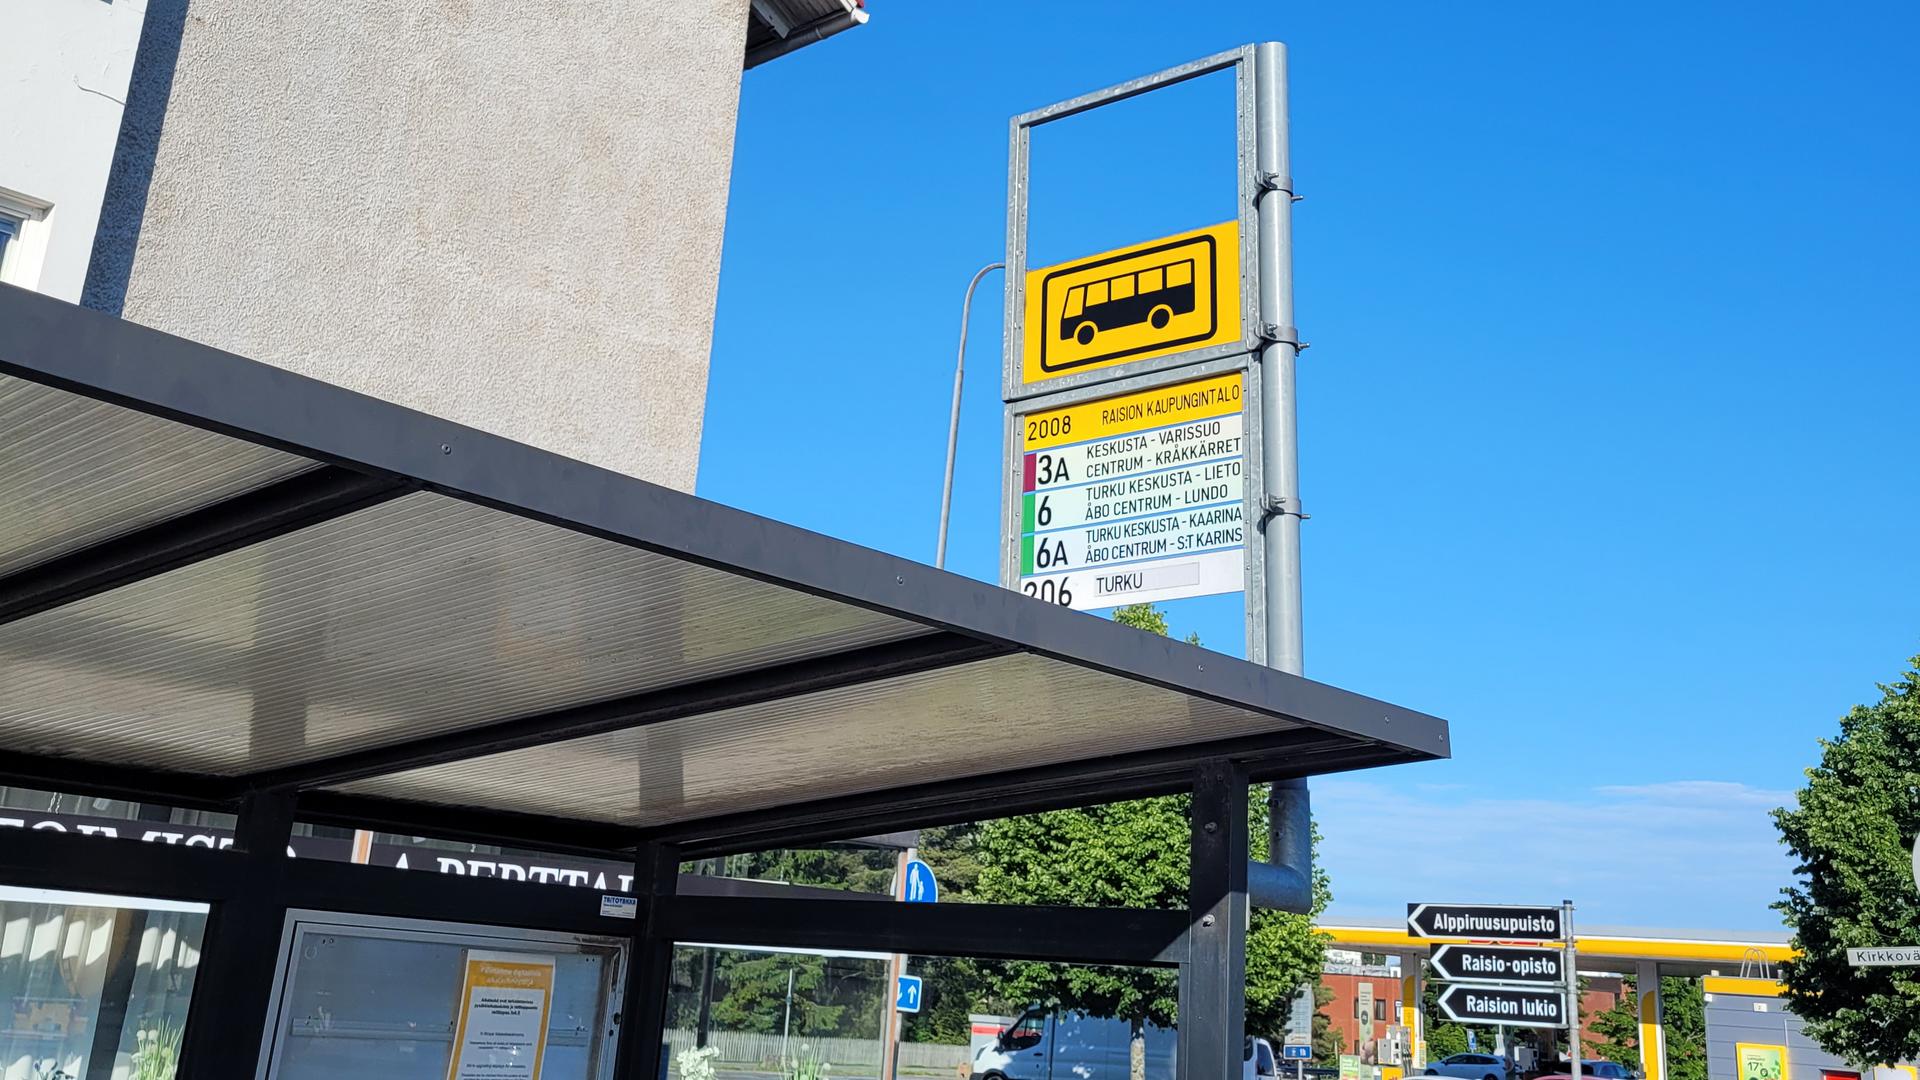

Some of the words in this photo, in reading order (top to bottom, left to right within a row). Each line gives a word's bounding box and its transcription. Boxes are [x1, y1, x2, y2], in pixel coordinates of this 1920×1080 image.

[1102, 405, 1143, 425] RAISION
[1147, 384, 1239, 417] KAUPUNGINTALO
[1028, 415, 1071, 441] 2008
[1087, 435, 1147, 459] KESKUSTA
[1159, 421, 1220, 444] VARISSUO
[1038, 454, 1070, 484] 3A
[1086, 456, 1143, 478] CENTRUM
[1155, 438, 1241, 466] KRÅKKÄRRET
[1085, 481, 1125, 501] TURKU
[1129, 471, 1192, 494] KESKUSTA
[1205, 462, 1240, 481] LIETO
[1038, 496, 1052, 526] 6
[1085, 503, 1109, 521] ÅBO
[1113, 494, 1171, 515] CENTRUM
[1185, 484, 1228, 504] LUNDO
[1085, 525, 1121, 543] TURKU
[1124, 517, 1179, 538] KESKUSTA
[1189, 507, 1242, 527] KAARINA
[1036, 538, 1068, 569] 6A
[1085, 546, 1108, 564] ÅBO
[1112, 539, 1166, 559] CENTRUM
[1177, 535, 1193, 550] S:T
[1197, 528, 1243, 547] KARINS
[1097, 573, 1143, 593] TURKU
[1434, 913, 1555, 933] Alppiruusupuisto
[1462, 954, 1556, 976] Raisio-opisto
[1857, 950, 1920, 961] Kirkkovä
[1466, 995, 1518, 1014] Raision
[1523, 999, 1557, 1016] lukio
